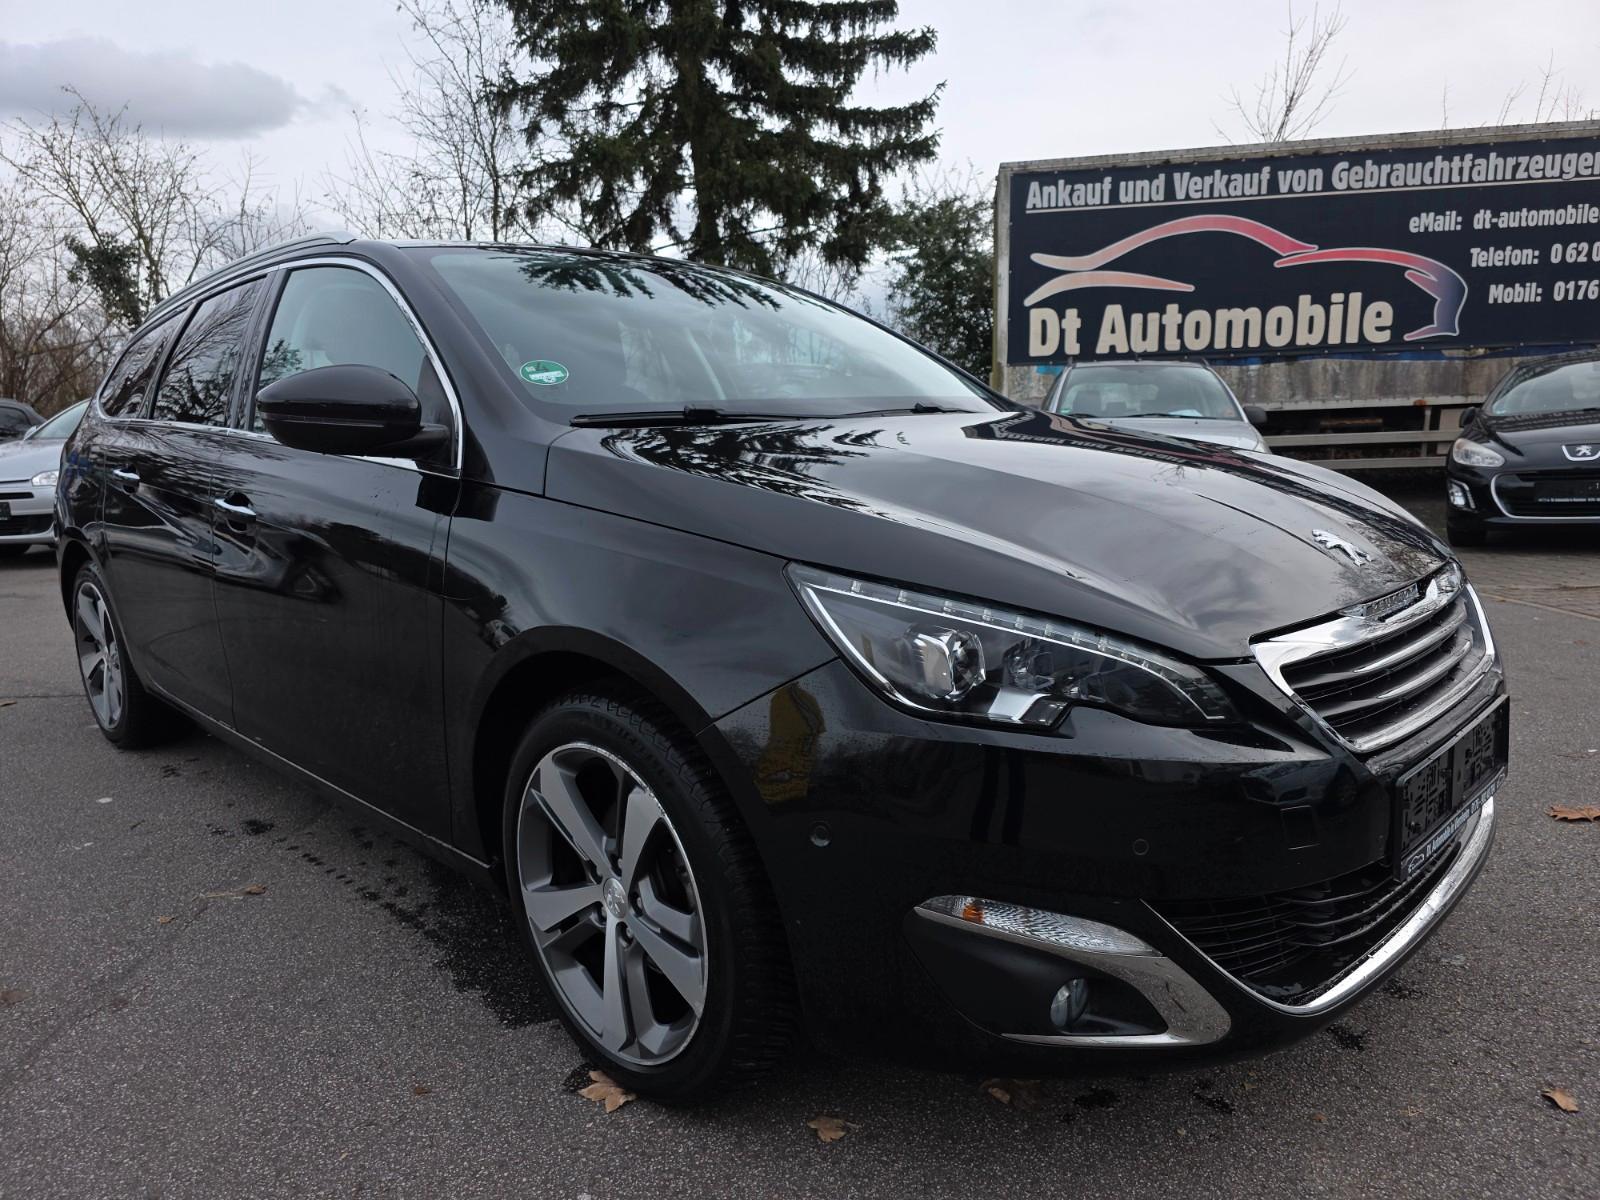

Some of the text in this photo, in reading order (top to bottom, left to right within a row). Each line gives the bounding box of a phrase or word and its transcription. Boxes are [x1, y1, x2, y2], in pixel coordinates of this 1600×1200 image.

[1026, 176, 1112, 209] Ankauf
[1119, 173, 1165, 204] und
[1173, 166, 1271, 200] Verkauf
[1277, 167, 1324, 194] von
[1409, 211, 1463, 233] eMail:
[1470, 246, 1540, 267] Telefon:
[1488, 279, 1600, 304] Mobil: 0176
[1029, 292, 1394, 356] Dt Automobile
